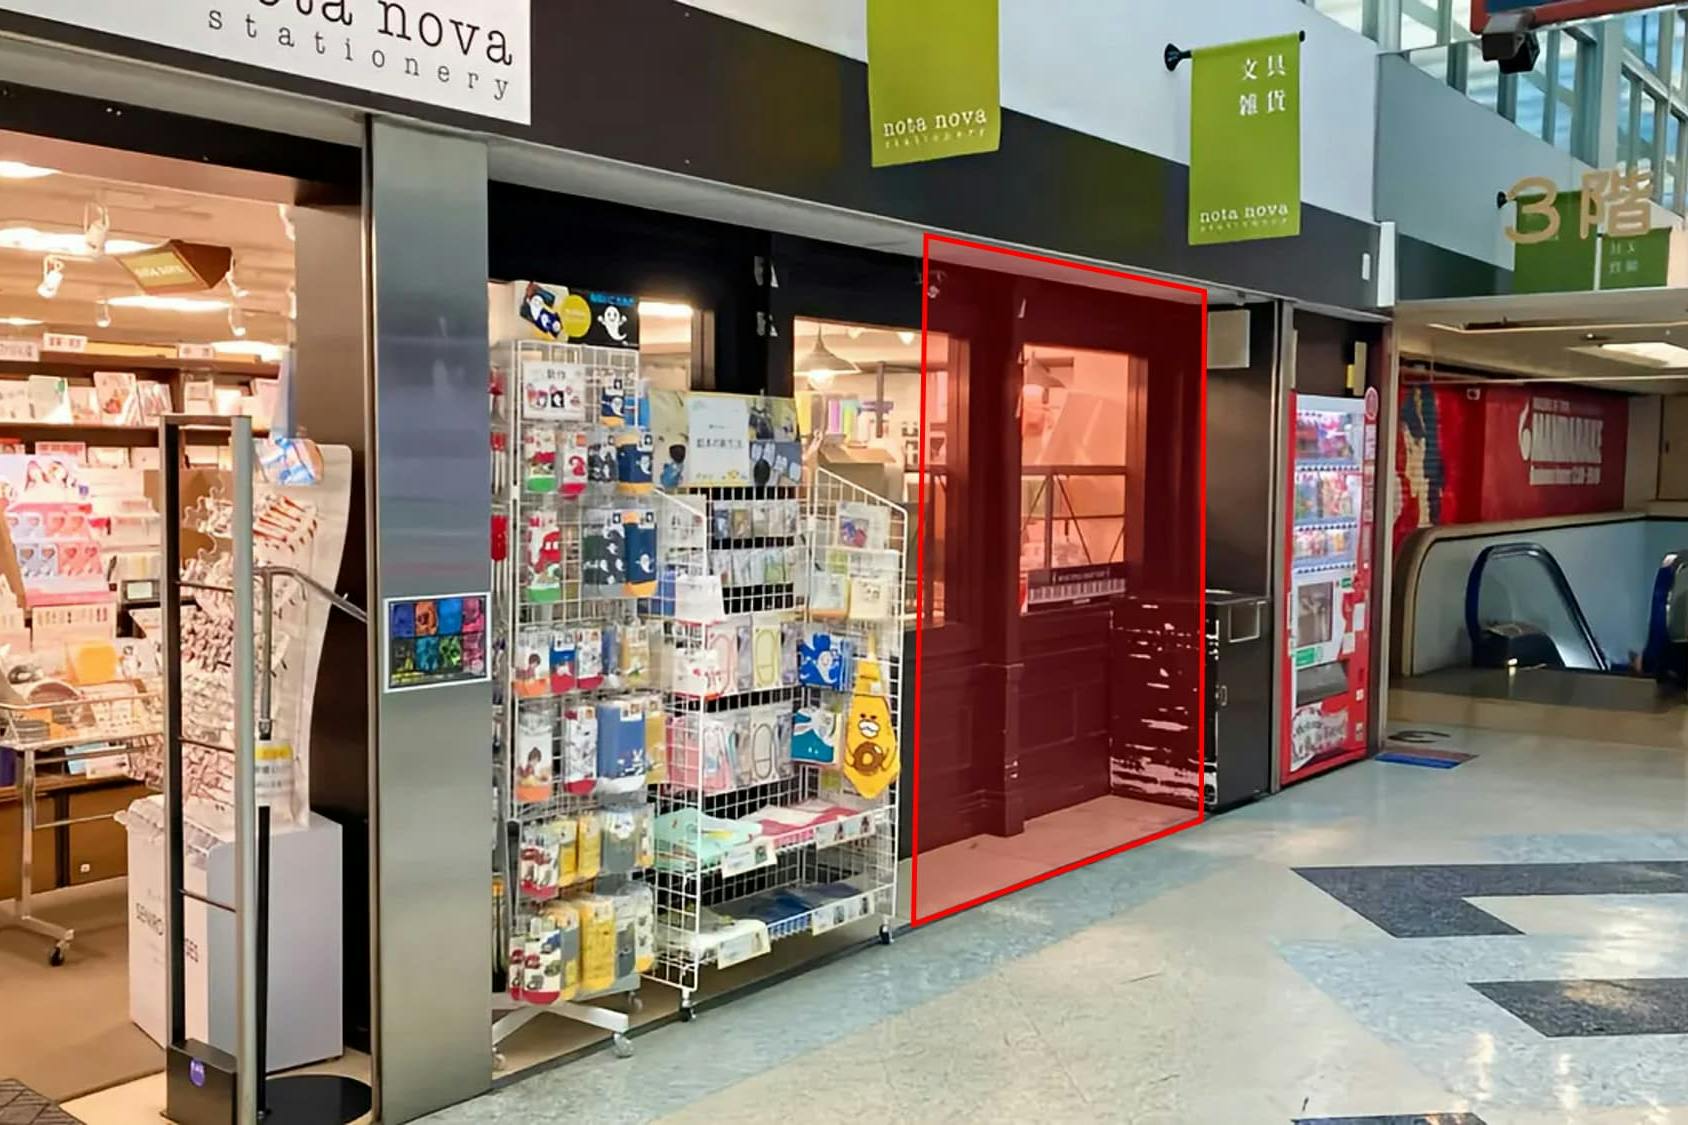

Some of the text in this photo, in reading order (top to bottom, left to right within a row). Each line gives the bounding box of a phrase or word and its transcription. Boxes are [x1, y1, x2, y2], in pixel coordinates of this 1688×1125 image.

[208, 9, 509, 100] stationery
[378, 0, 512, 65] nova
[1242, 54, 1286, 80] 文具
[884, 108, 987, 137] nota nova
[1200, 204, 1289, 223] nota nova
[1505, 166, 1653, 244] 3階
